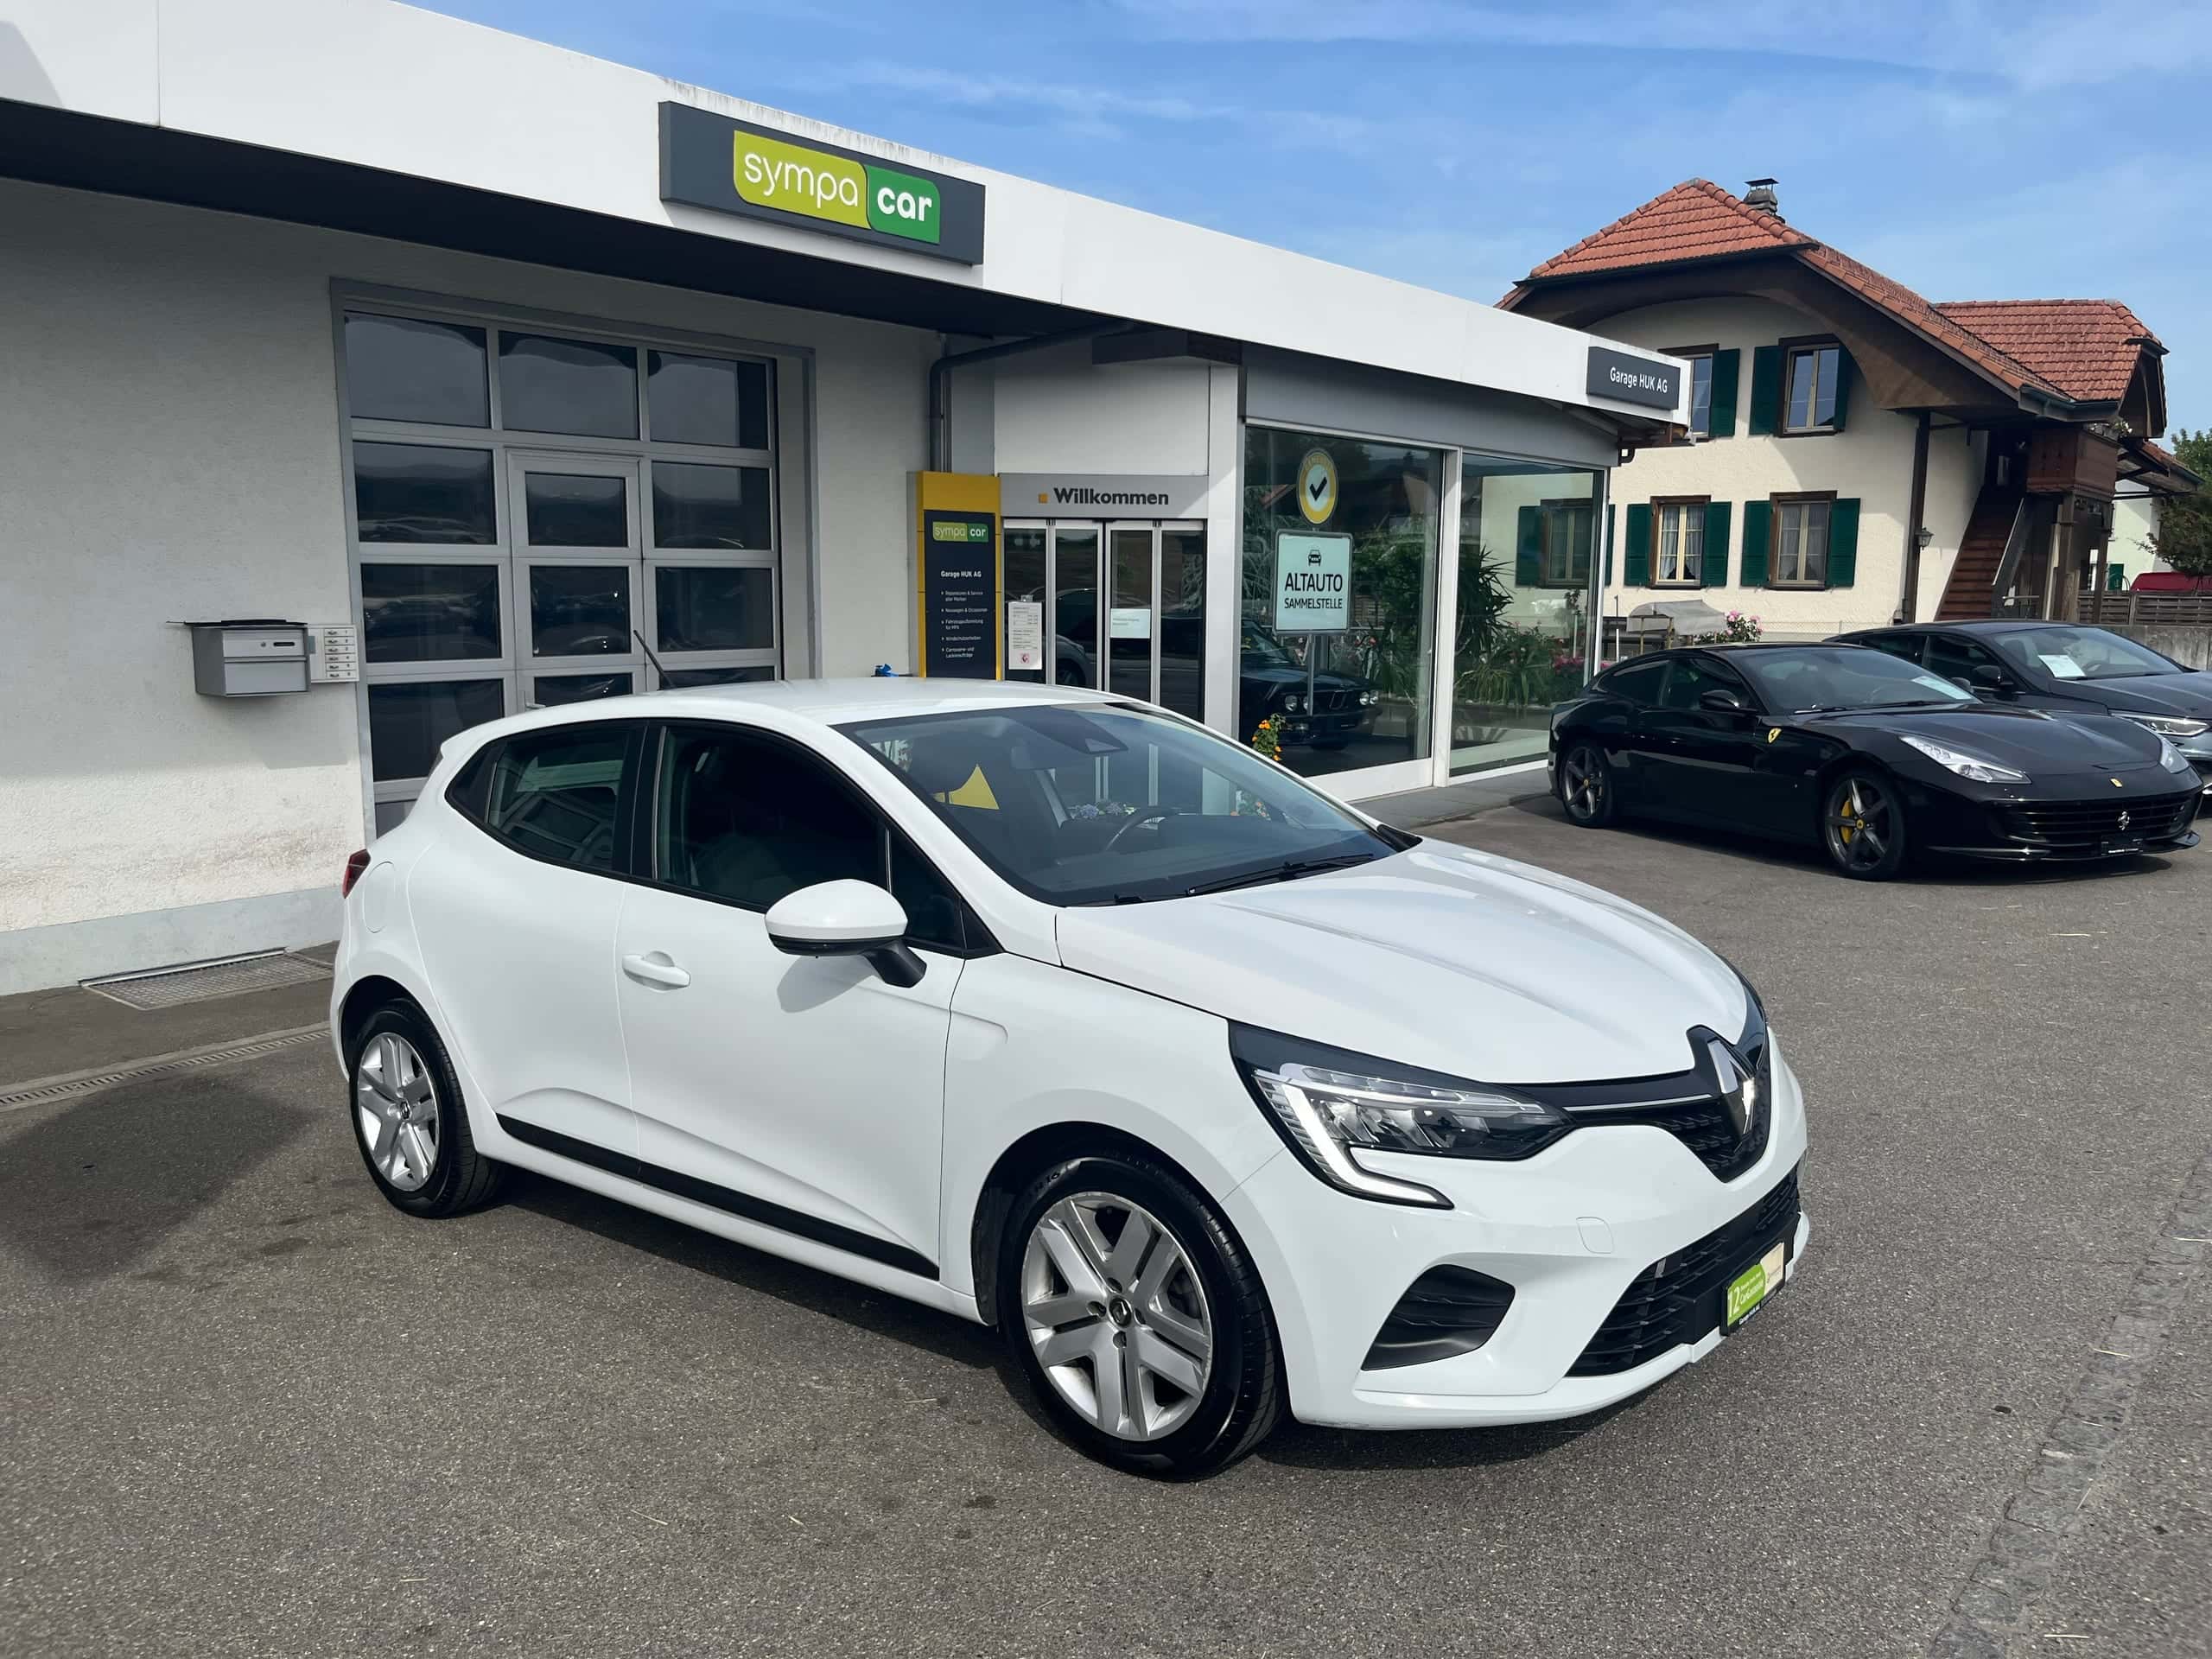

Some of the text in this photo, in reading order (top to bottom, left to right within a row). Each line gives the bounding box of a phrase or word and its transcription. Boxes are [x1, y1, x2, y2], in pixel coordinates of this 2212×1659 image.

[744, 153, 932, 222] sympa car
[1610, 366, 1668, 393] Garage HUK AG
[1053, 487, 1169, 505] Willkommen
[934, 526, 986, 540] sympa car
[941, 570, 960, 579] Garage
[1284, 573, 1343, 592] ALTAUTO
[1284, 598, 1343, 609] SAMMELSTELLE
[1728, 1286, 1740, 1319] 12
